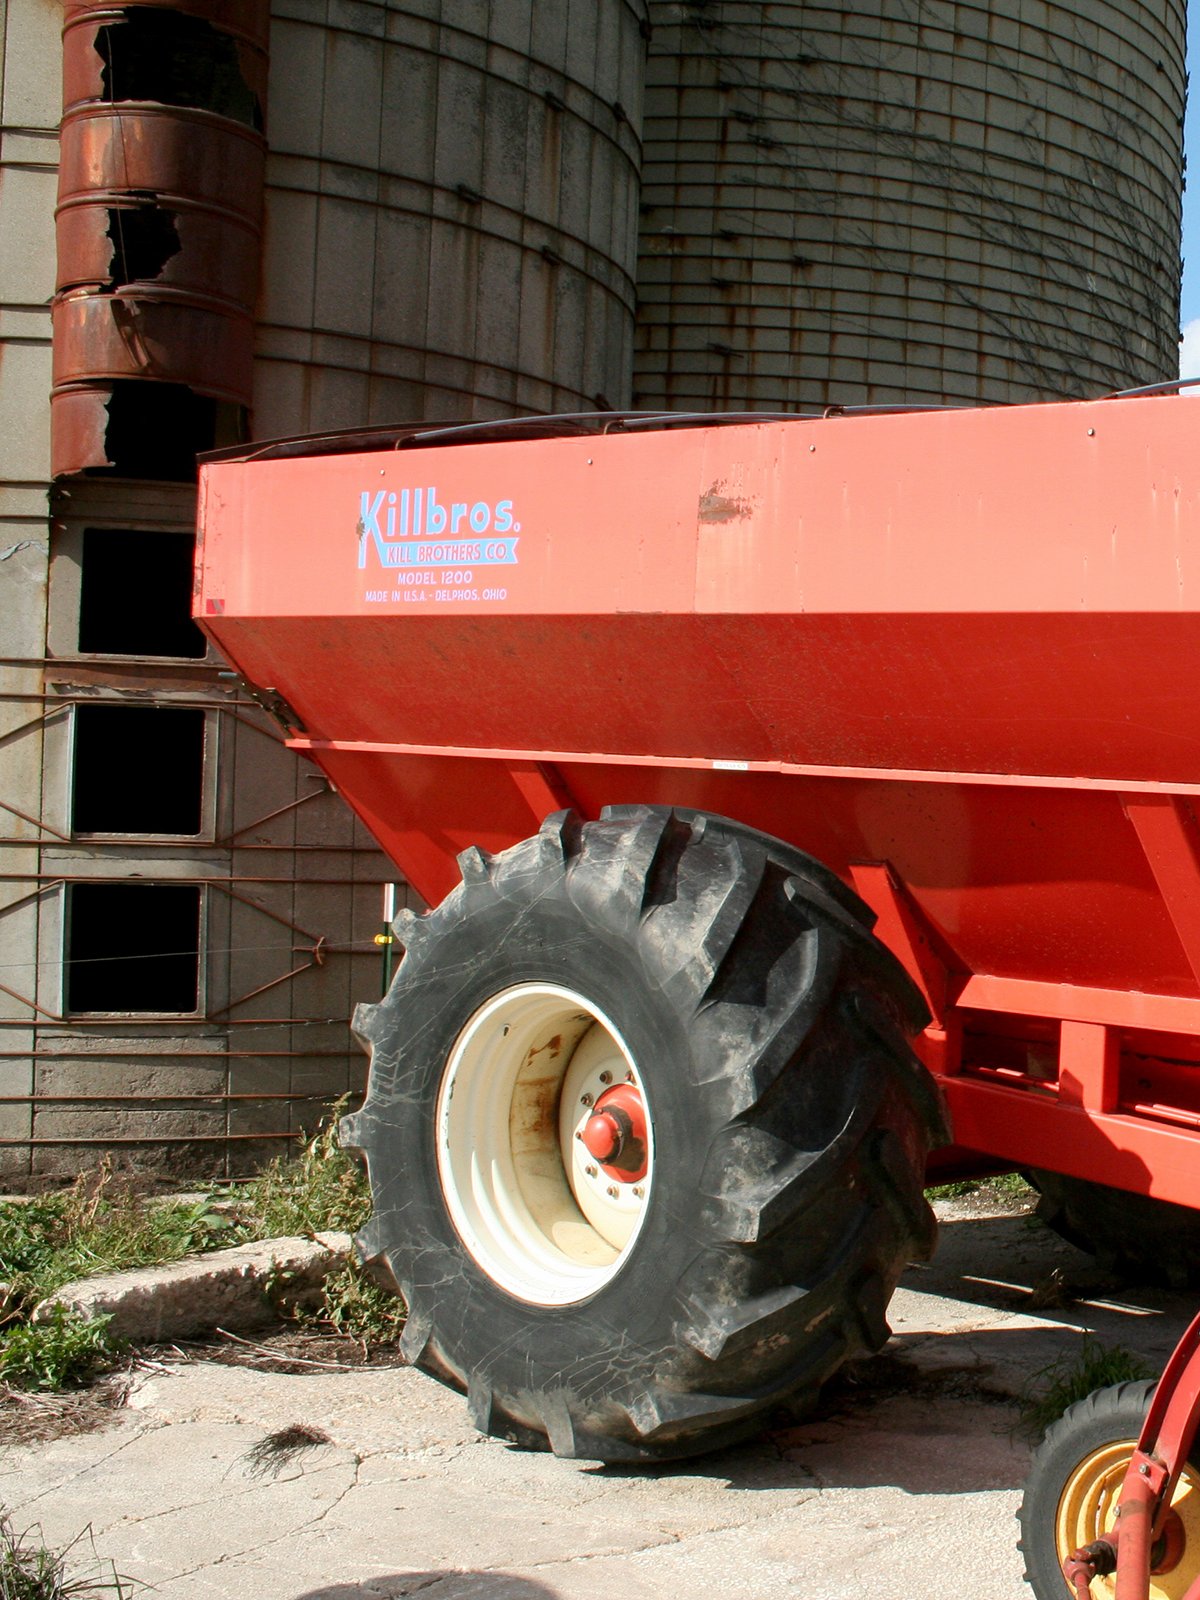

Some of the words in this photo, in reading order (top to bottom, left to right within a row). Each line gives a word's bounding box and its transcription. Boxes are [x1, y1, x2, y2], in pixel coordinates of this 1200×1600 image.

[388, 546, 412, 563] KILL
[417, 543, 481, 561] BROTHERS
[485, 542, 508, 559] CO.
[397, 571, 436, 585] MODEL
[441, 570, 473, 584] 1200
[365, 590, 388, 602] MADE
[391, 590, 400, 601] IN
[482, 588, 507, 601] OHIO
